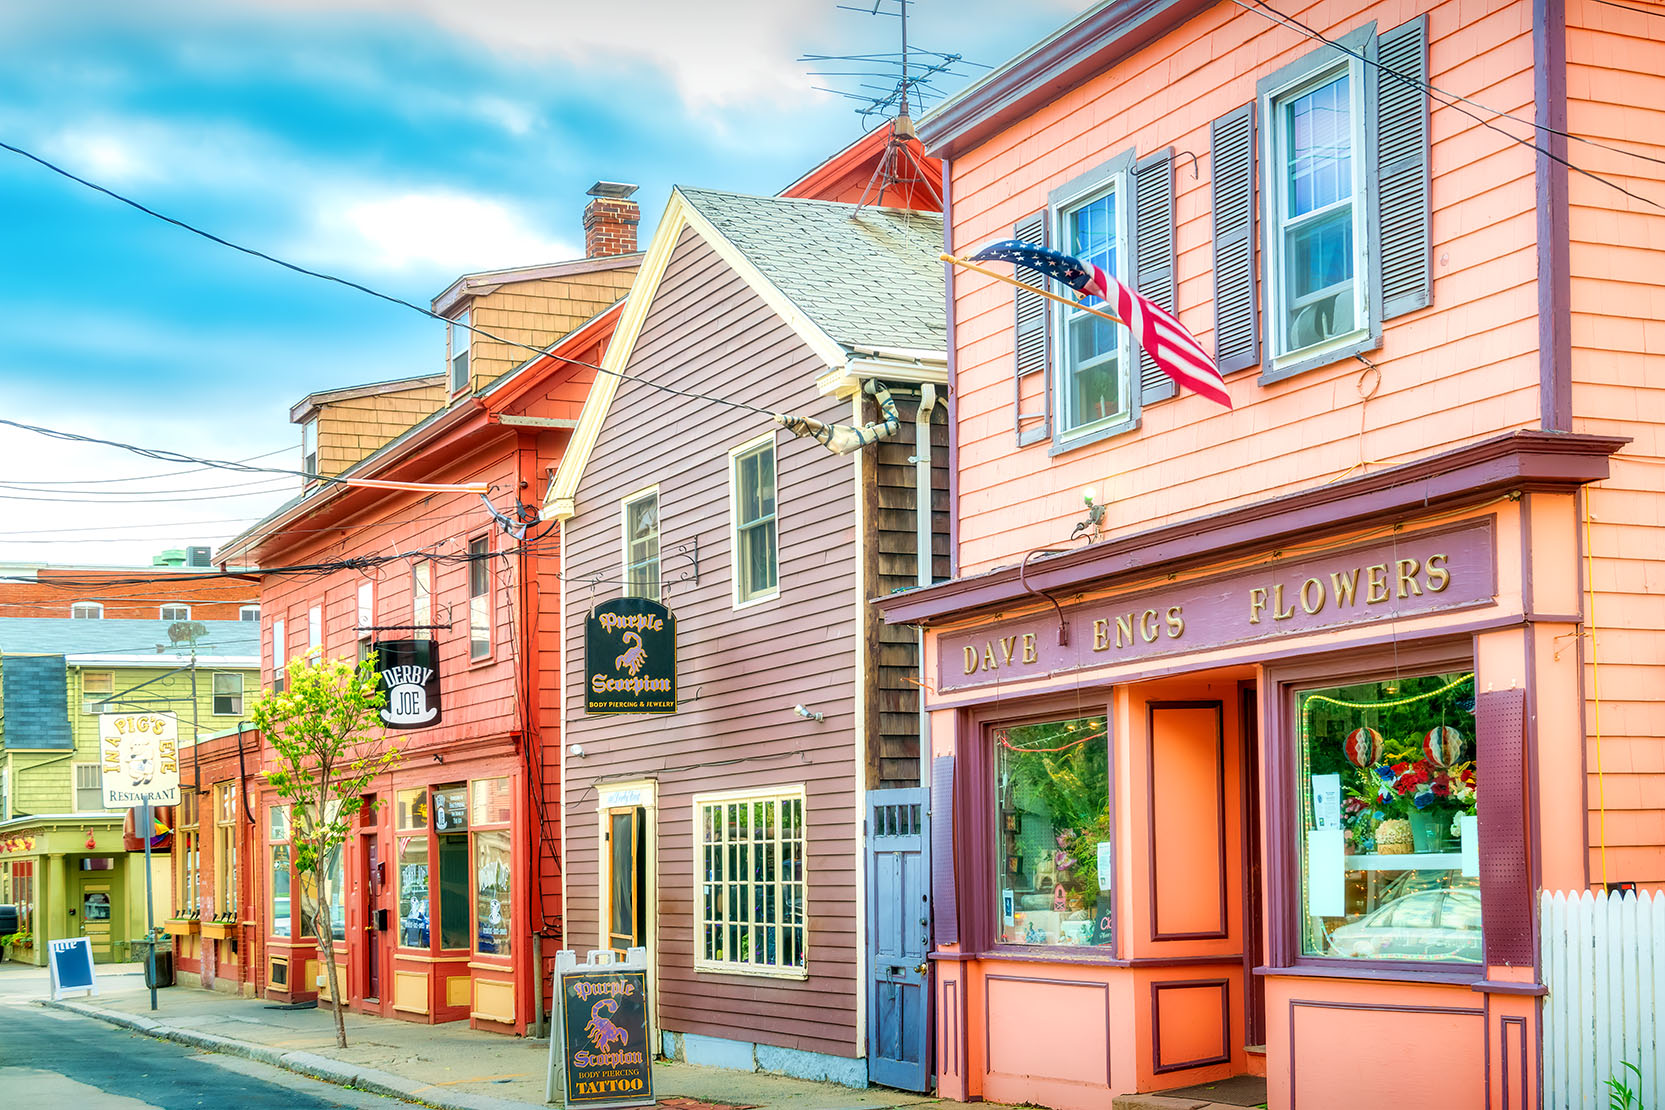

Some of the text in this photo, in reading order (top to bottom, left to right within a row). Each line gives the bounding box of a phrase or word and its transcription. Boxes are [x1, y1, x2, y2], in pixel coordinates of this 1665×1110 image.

[599, 612, 663, 634] Purple
[962, 553, 1451, 675] DAVE ENGS FLOWERS
[382, 665, 434, 688] DERBY
[592, 673, 671, 696] Scorpion
[396, 691, 420, 715] JOE
[103, 716, 177, 774] IN A PIG'S EYE
[574, 979, 635, 1001] Purple
[574, 1049, 643, 1069] Scorpion
[579, 1069, 640, 1079] BODY PIERCING
[576, 1078, 644, 1094] TATTOO
